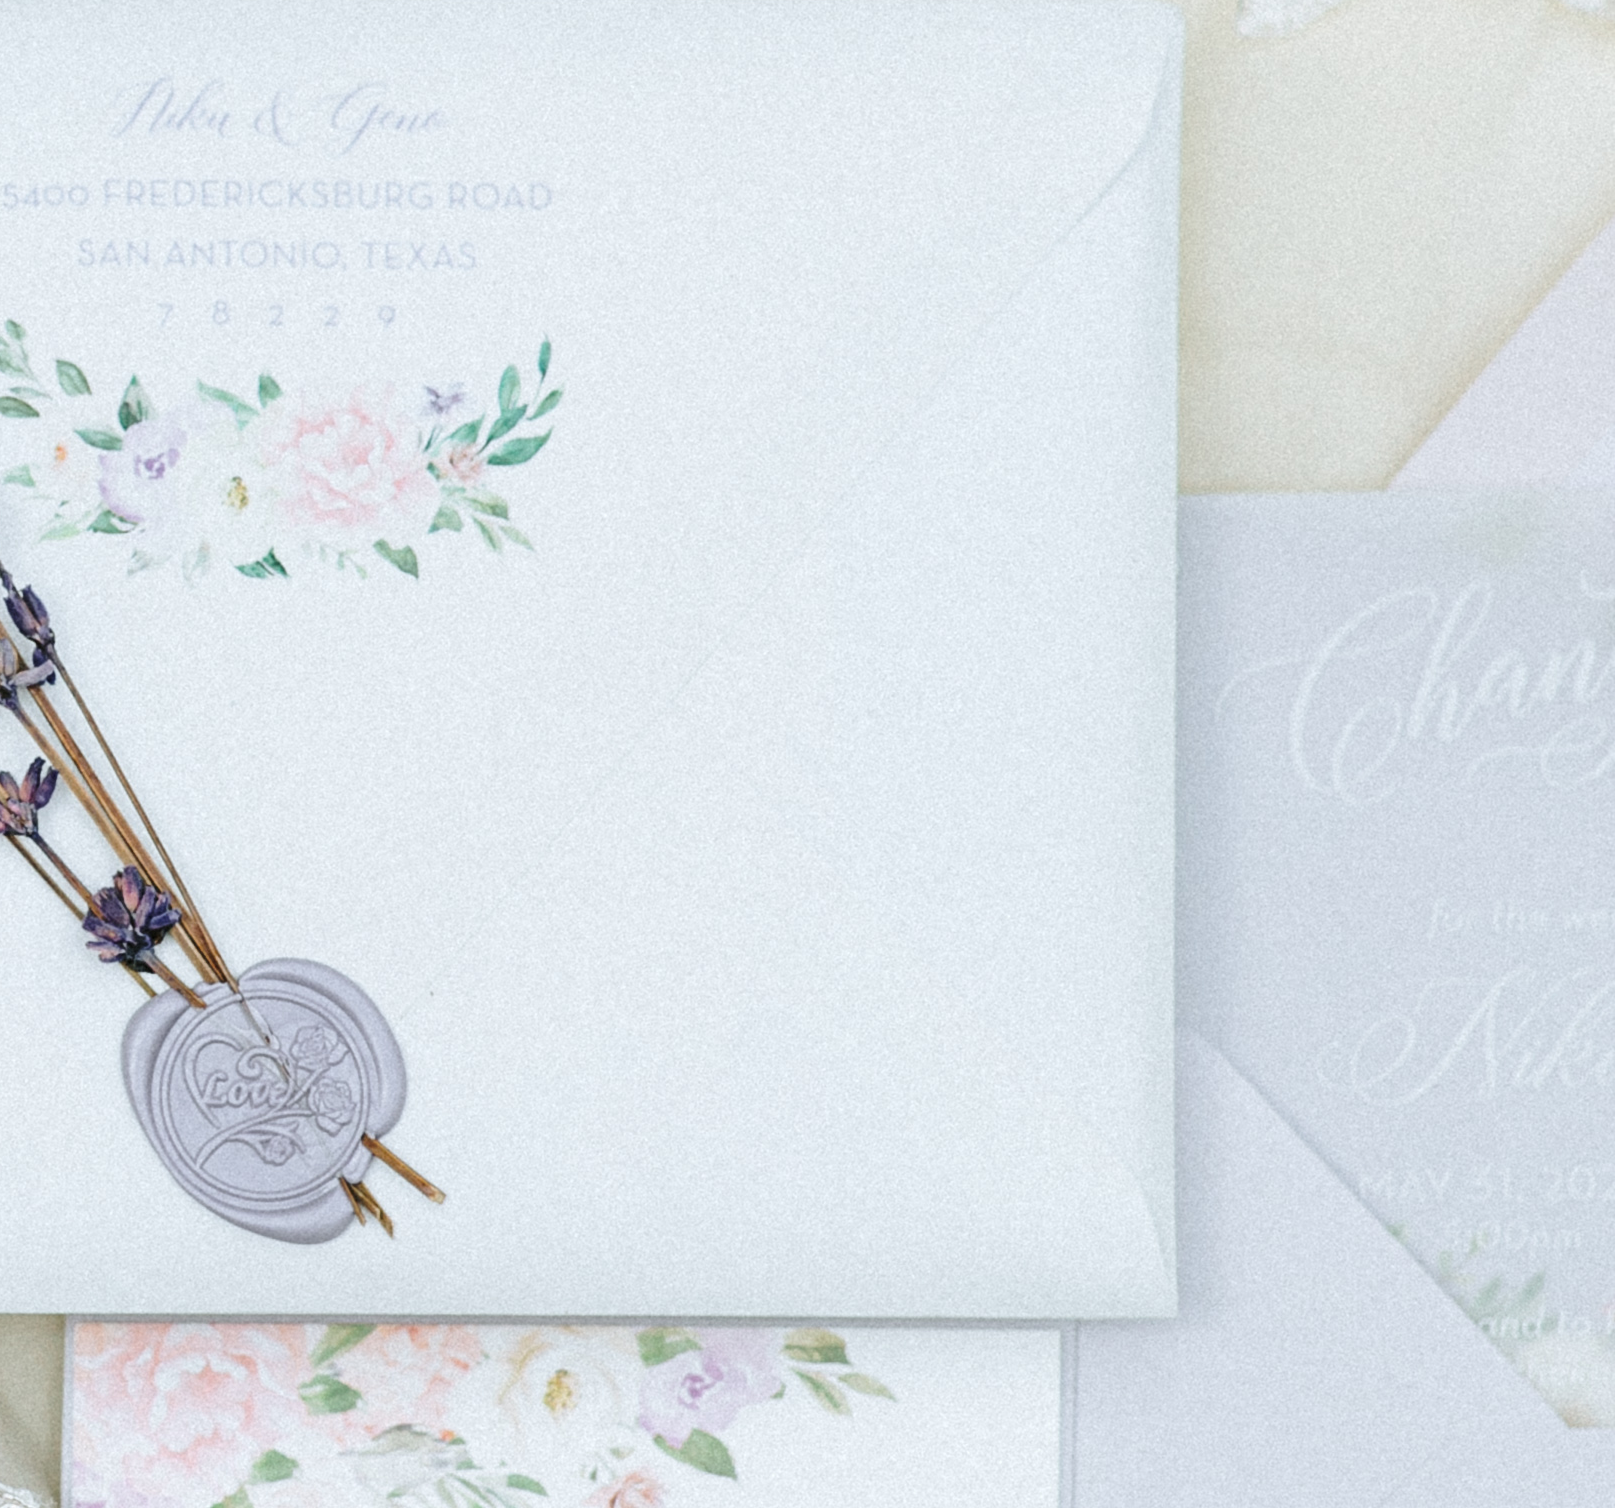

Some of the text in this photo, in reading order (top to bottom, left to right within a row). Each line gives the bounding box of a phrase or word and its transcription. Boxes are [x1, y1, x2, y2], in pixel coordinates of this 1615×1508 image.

[252, 86, 304, 147] &
[2, 178, 553, 212] 5400 FREDERICKSBURG ROAD
[77, 238, 477, 272] SAN ANTONIO, TEXAS
[203, 1071, 288, 1109] Love
